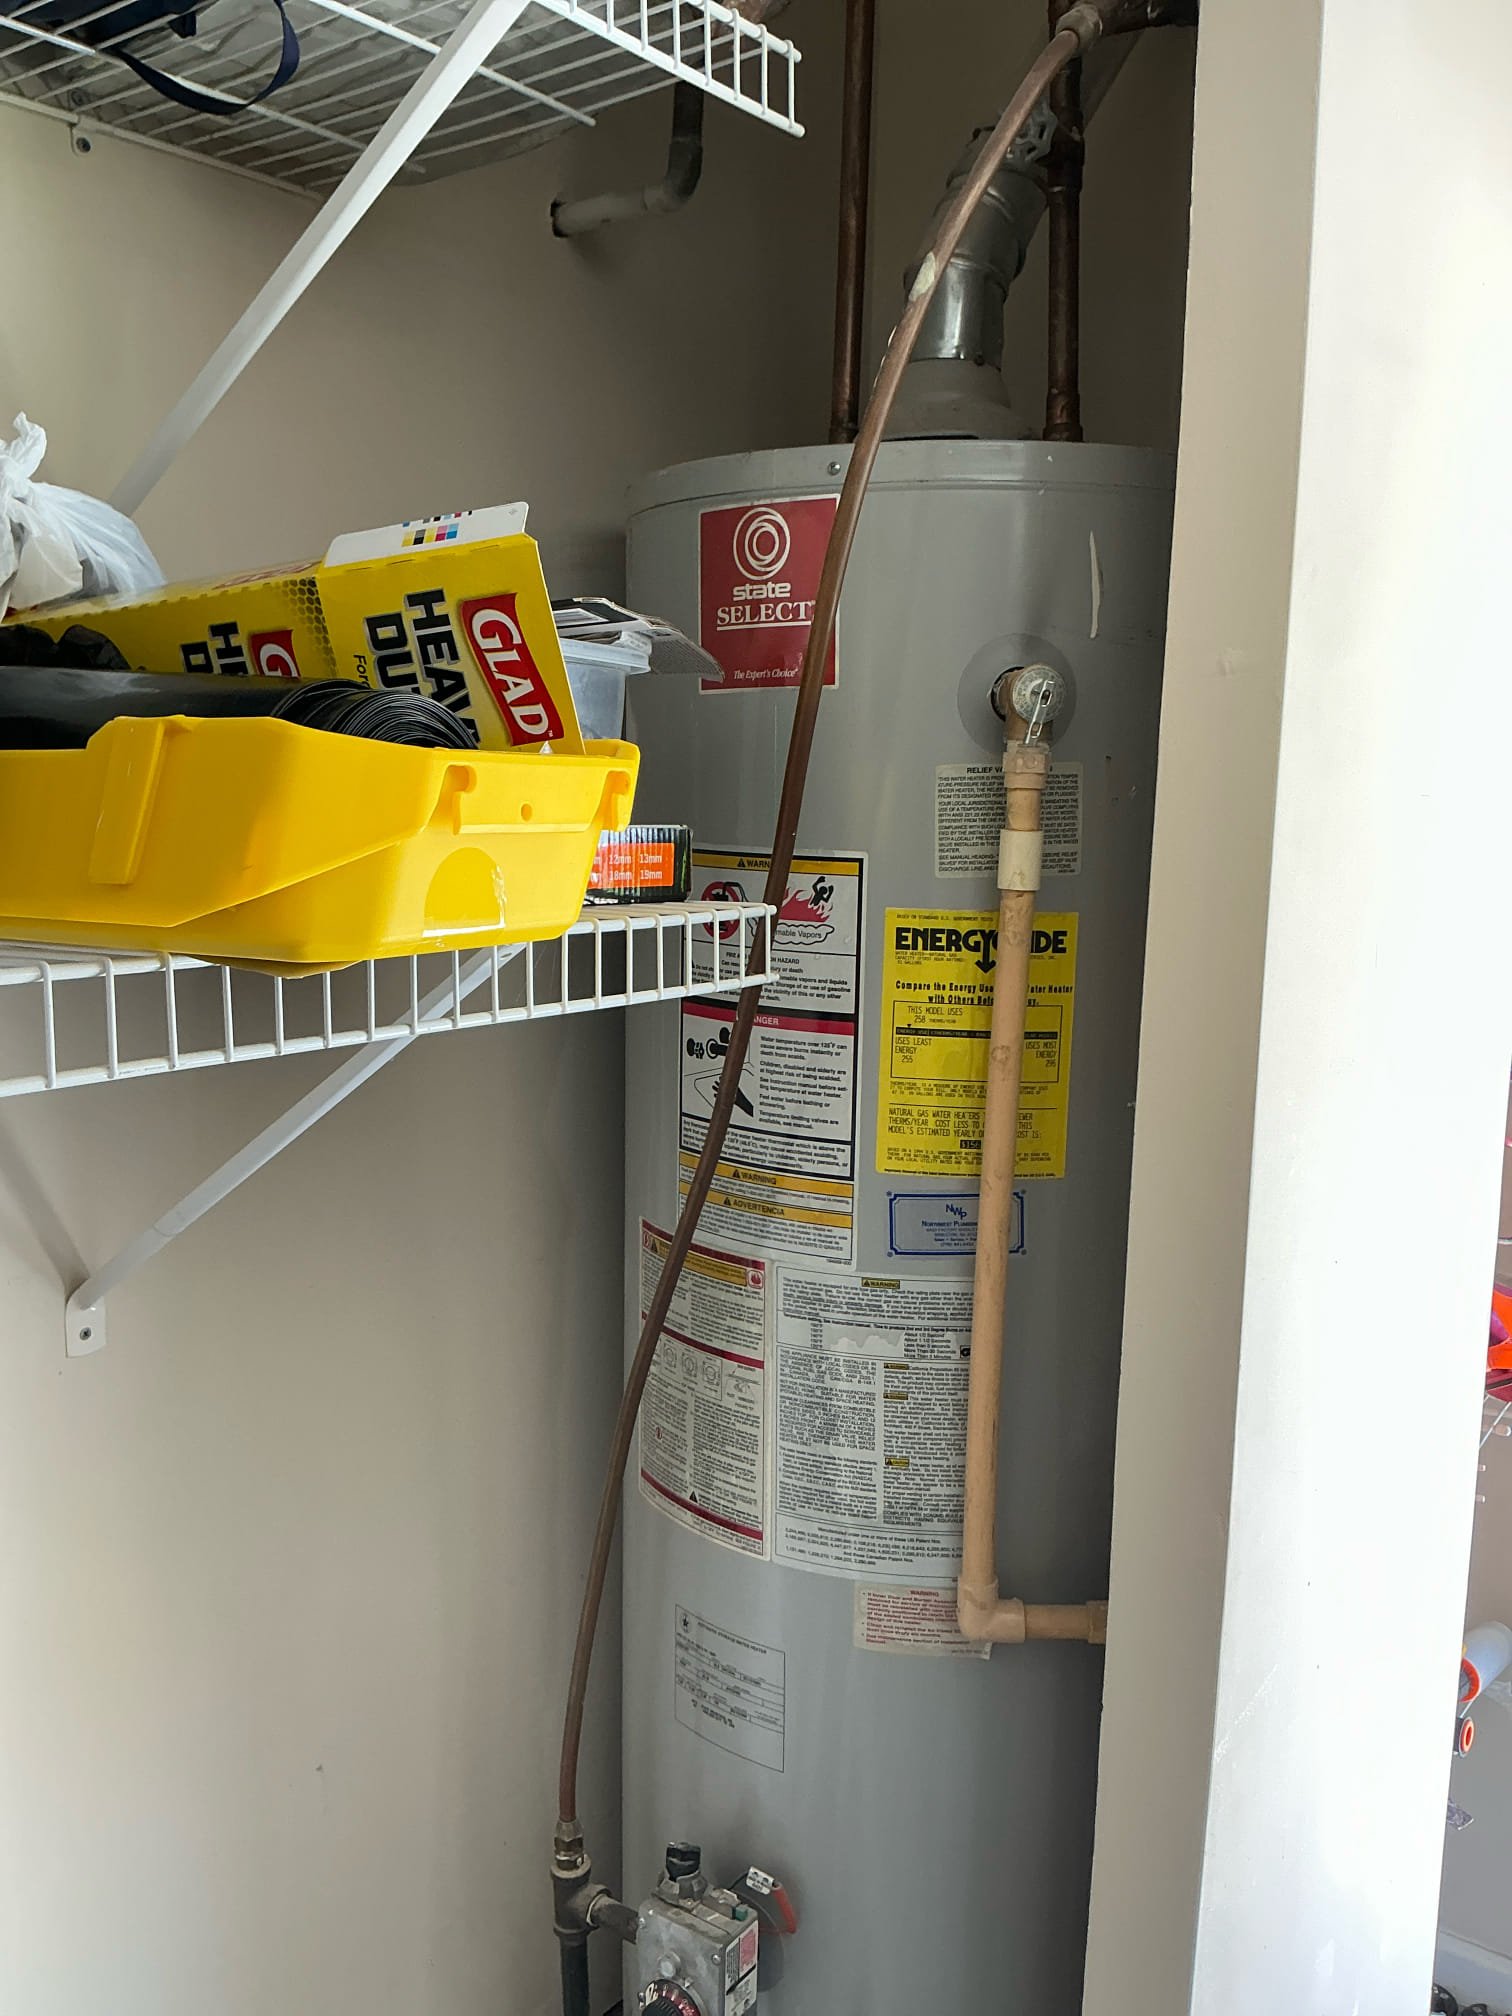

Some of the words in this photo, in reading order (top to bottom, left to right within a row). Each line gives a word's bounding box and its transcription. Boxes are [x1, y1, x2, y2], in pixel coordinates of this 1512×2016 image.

[733, 582, 791, 601] state
[717, 601, 812, 625] SELECT
[472, 609, 549, 735] GLAD
[734, 670, 745, 679] The
[746, 670, 771, 680] Expert's
[640, 854, 662, 864] 13mm
[747, 859, 770, 868] WARN
[798, 931, 822, 943] Vapors
[895, 927, 1067, 954] ENERGYIDE
[776, 982, 795, 990] Storage
[895, 980, 930, 992] Compare
[933, 982, 946, 991] the
[949, 982, 977, 994] Energy
[1049, 985, 1073, 993] Heater
[928, 994, 945, 1005] with
[908, 1006, 922, 1014] THIS
[926, 1006, 945, 1015] MODEL
[948, 1007, 963, 1016] USES
[753, 1016, 779, 1025] ANGER
[914, 1014, 926, 1023] 258
[776, 1038, 806, 1046] temperature
[895, 1037, 910, 1046] USES
[914, 1038, 932, 1046] LEAST
[895, 1046, 917, 1055] ENERGY
[889, 1108, 914, 1117] NATURAL
[917, 1109, 929, 1118] GAS
[932, 1110, 951, 1120] WATER
[954, 1111, 980, 1120] HEATERS
[889, 1116, 929, 1127] THERMS/YEAR
[935, 1119, 951, 1128] COST
[954, 1120, 970, 1129] LESS
[972, 1121, 980, 1129] TO
[888, 1125, 914, 1136] MODEL'S
[917, 1127, 951, 1137] ESTIMATED
[954, 1129, 977, 1138] YEARLY
[741, 1172, 777, 1185] WARNING
[733, 1200, 784, 1216] ADVERTENCIA
[946, 1204, 967, 1220] NWP
